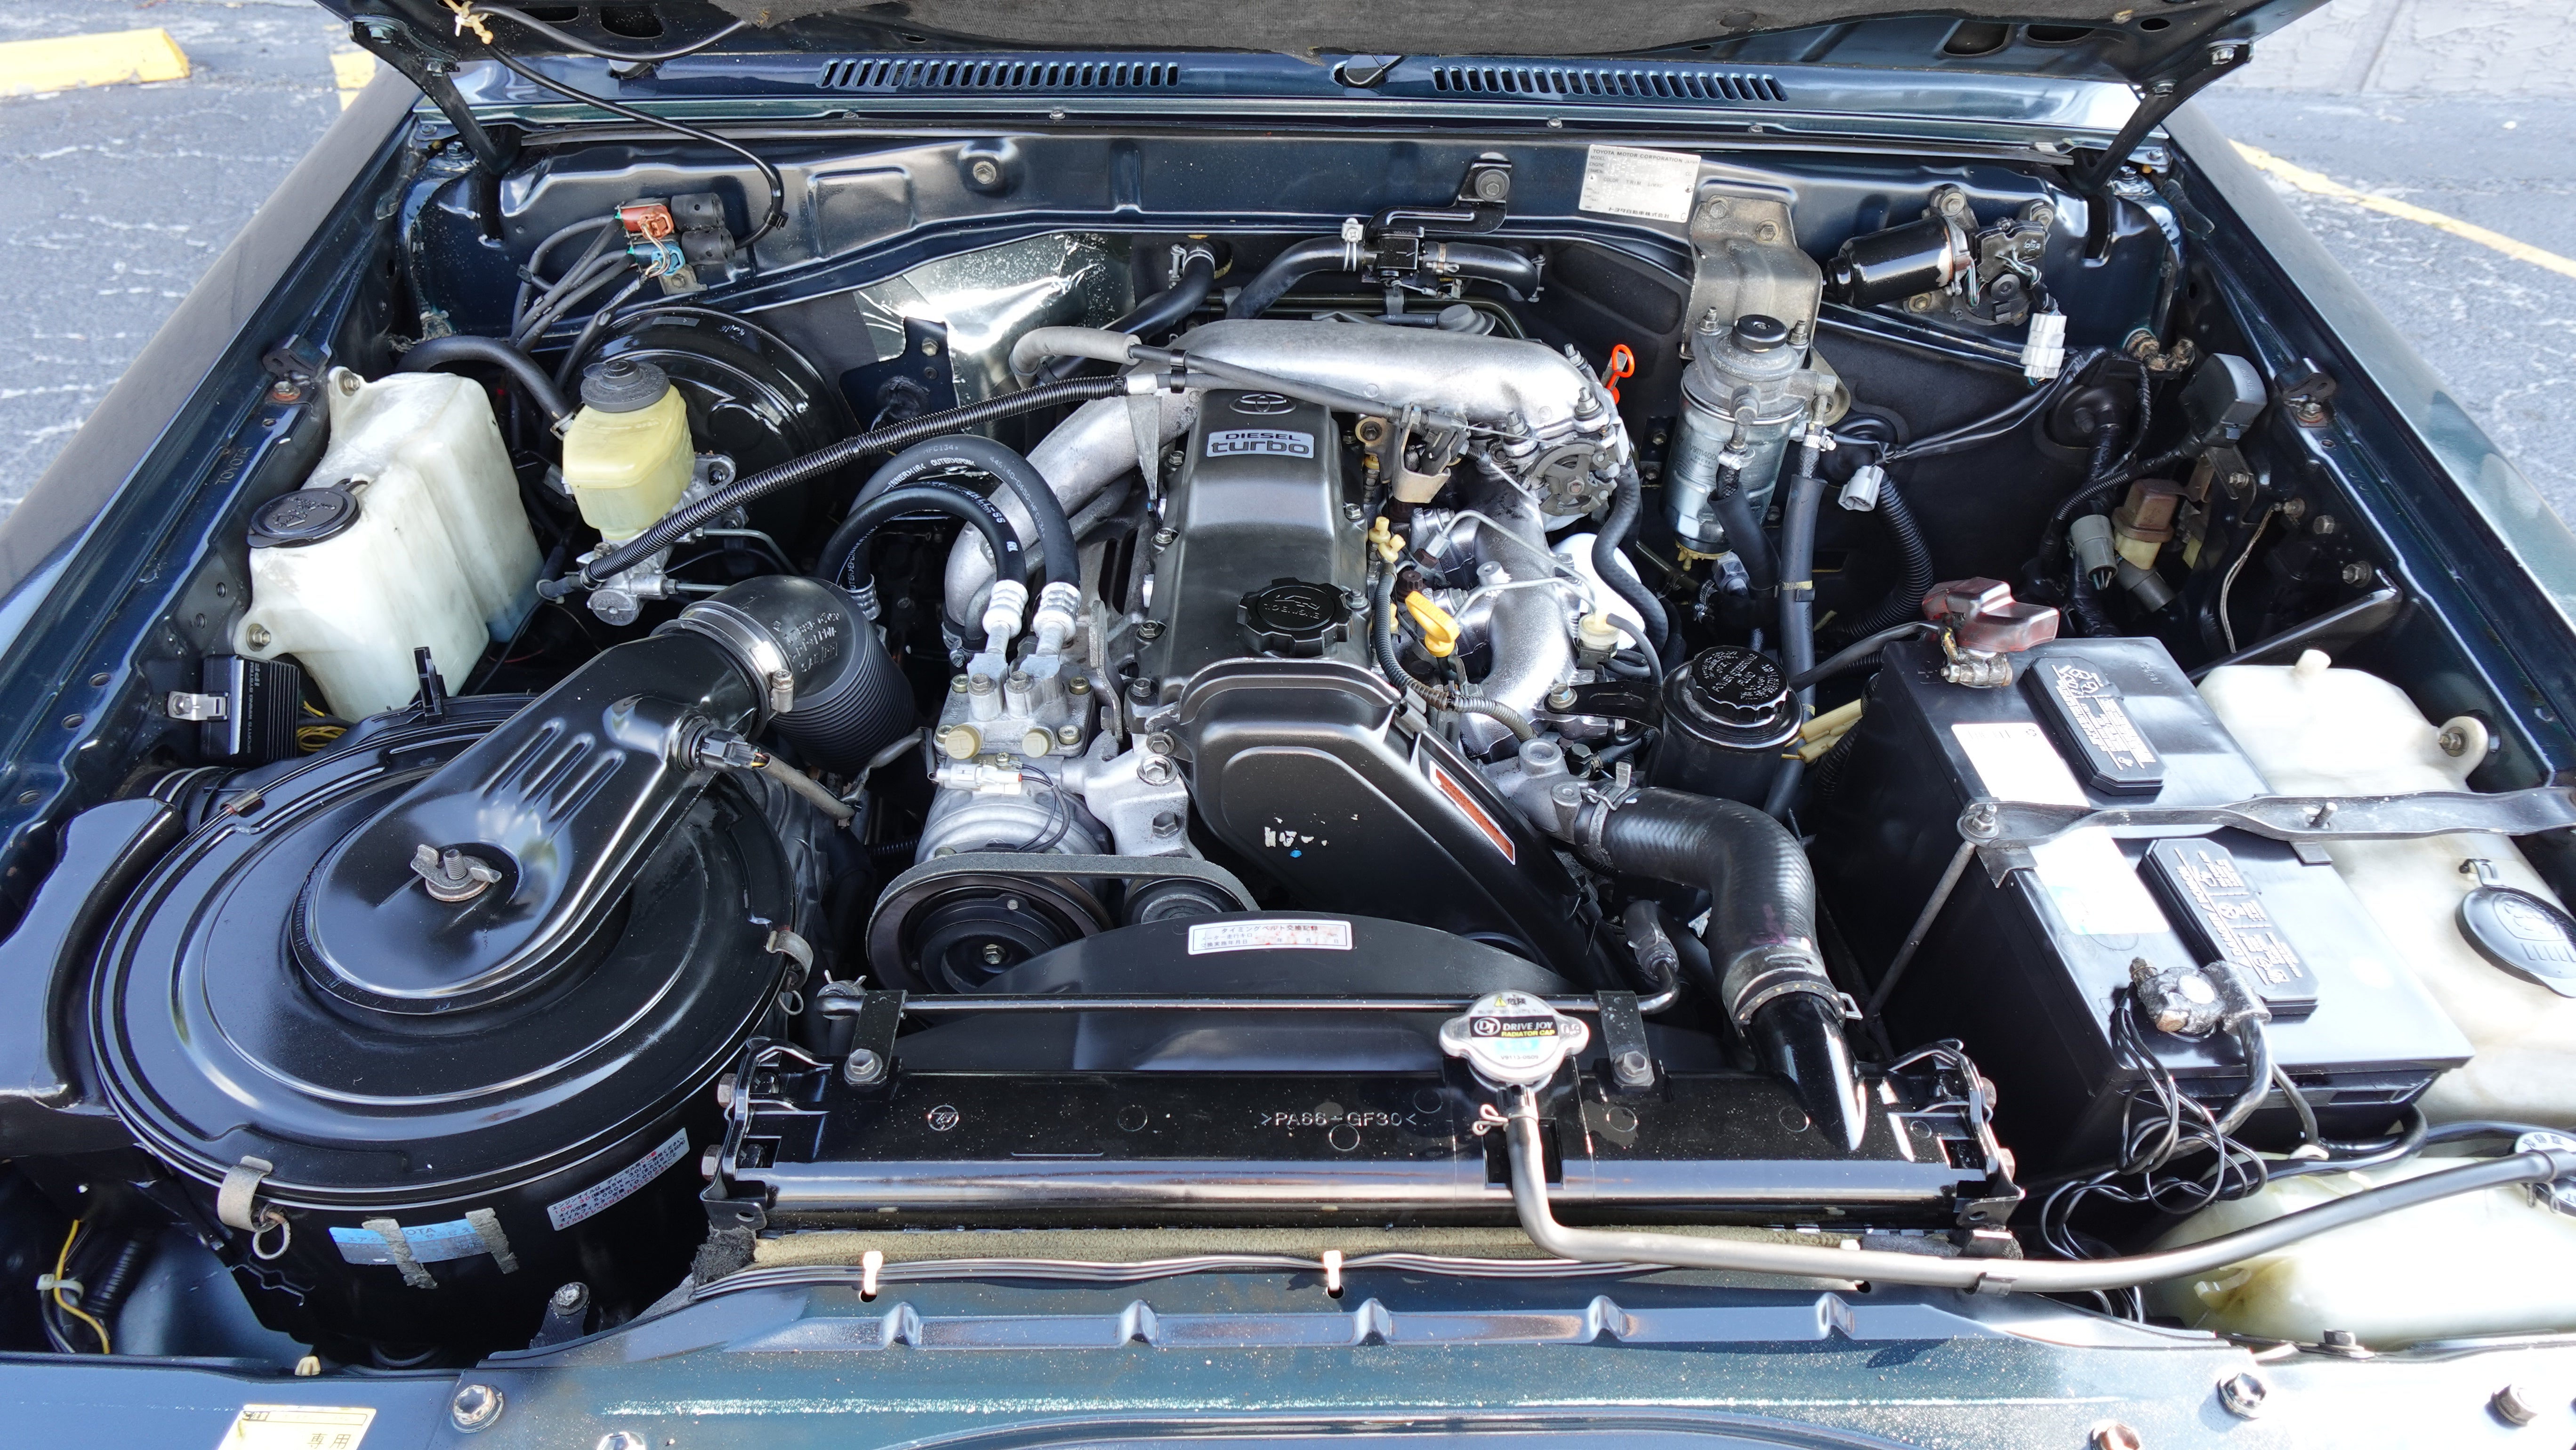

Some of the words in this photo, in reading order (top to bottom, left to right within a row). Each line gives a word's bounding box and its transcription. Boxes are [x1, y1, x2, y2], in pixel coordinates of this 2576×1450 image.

[1640, 153, 1683, 163] CORPORATION
[1609, 207, 1670, 218] トヨタ自動車株式会社
[1225, 433, 1301, 441] DIESEL
[1211, 441, 1310, 454] turbo
[215, 446, 253, 485] TOYOTA
[2176, 866, 2210, 903] POISON
[1222, 925, 1319, 934] タイミングベルト交換記録
[2207, 912, 2245, 957] DANGER
[1507, 997, 1527, 1006] 危険
[1503, 1022, 1534, 1031] DRIVE
[1535, 1021, 1554, 1031] JOY
[405, 1227, 436, 1235] OTA
[307, 1433, 352, 1450] 専用
